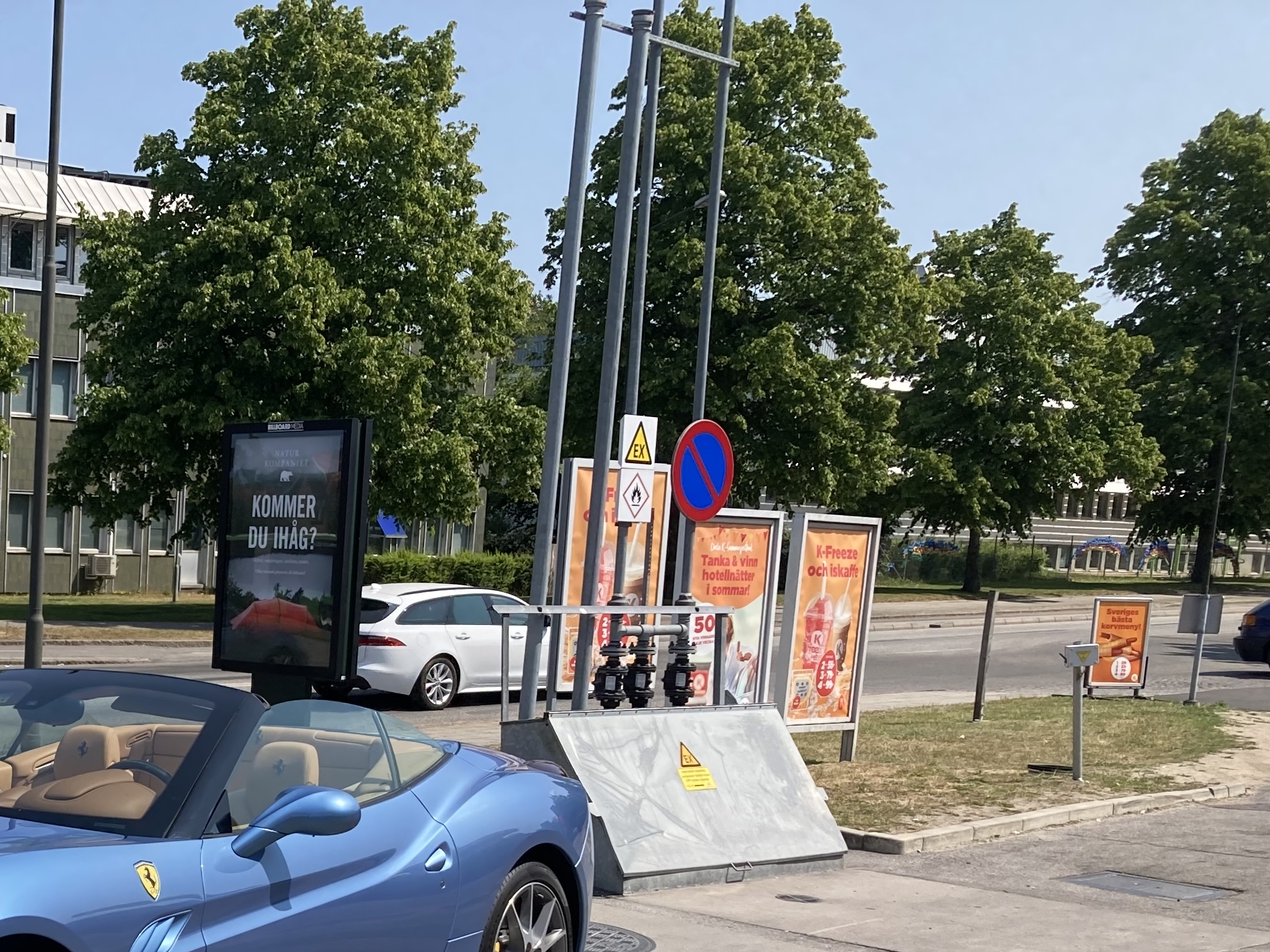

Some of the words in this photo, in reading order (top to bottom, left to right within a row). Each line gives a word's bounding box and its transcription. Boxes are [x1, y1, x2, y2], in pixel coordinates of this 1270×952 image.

[274, 449, 300, 458] NATUR
[633, 443, 646, 459] EX
[264, 459, 309, 468] KOMPANIET
[251, 494, 317, 518] KOMMER
[248, 525, 269, 549] DU
[273, 519, 318, 550] IHÅG?
[816, 544, 858, 560] K-Freeze
[701, 554, 730, 567] Tanka
[731, 555, 738, 567] &
[739, 555, 759, 567] vinn
[702, 568, 755, 582] hotellnätter
[807, 563, 829, 577] och
[830, 563, 859, 578] iskaffe
[705, 583, 711, 596] i
[711, 584, 751, 596] sommar!
[1106, 608, 1139, 616] Sveriges
[694, 614, 715, 634] 50
